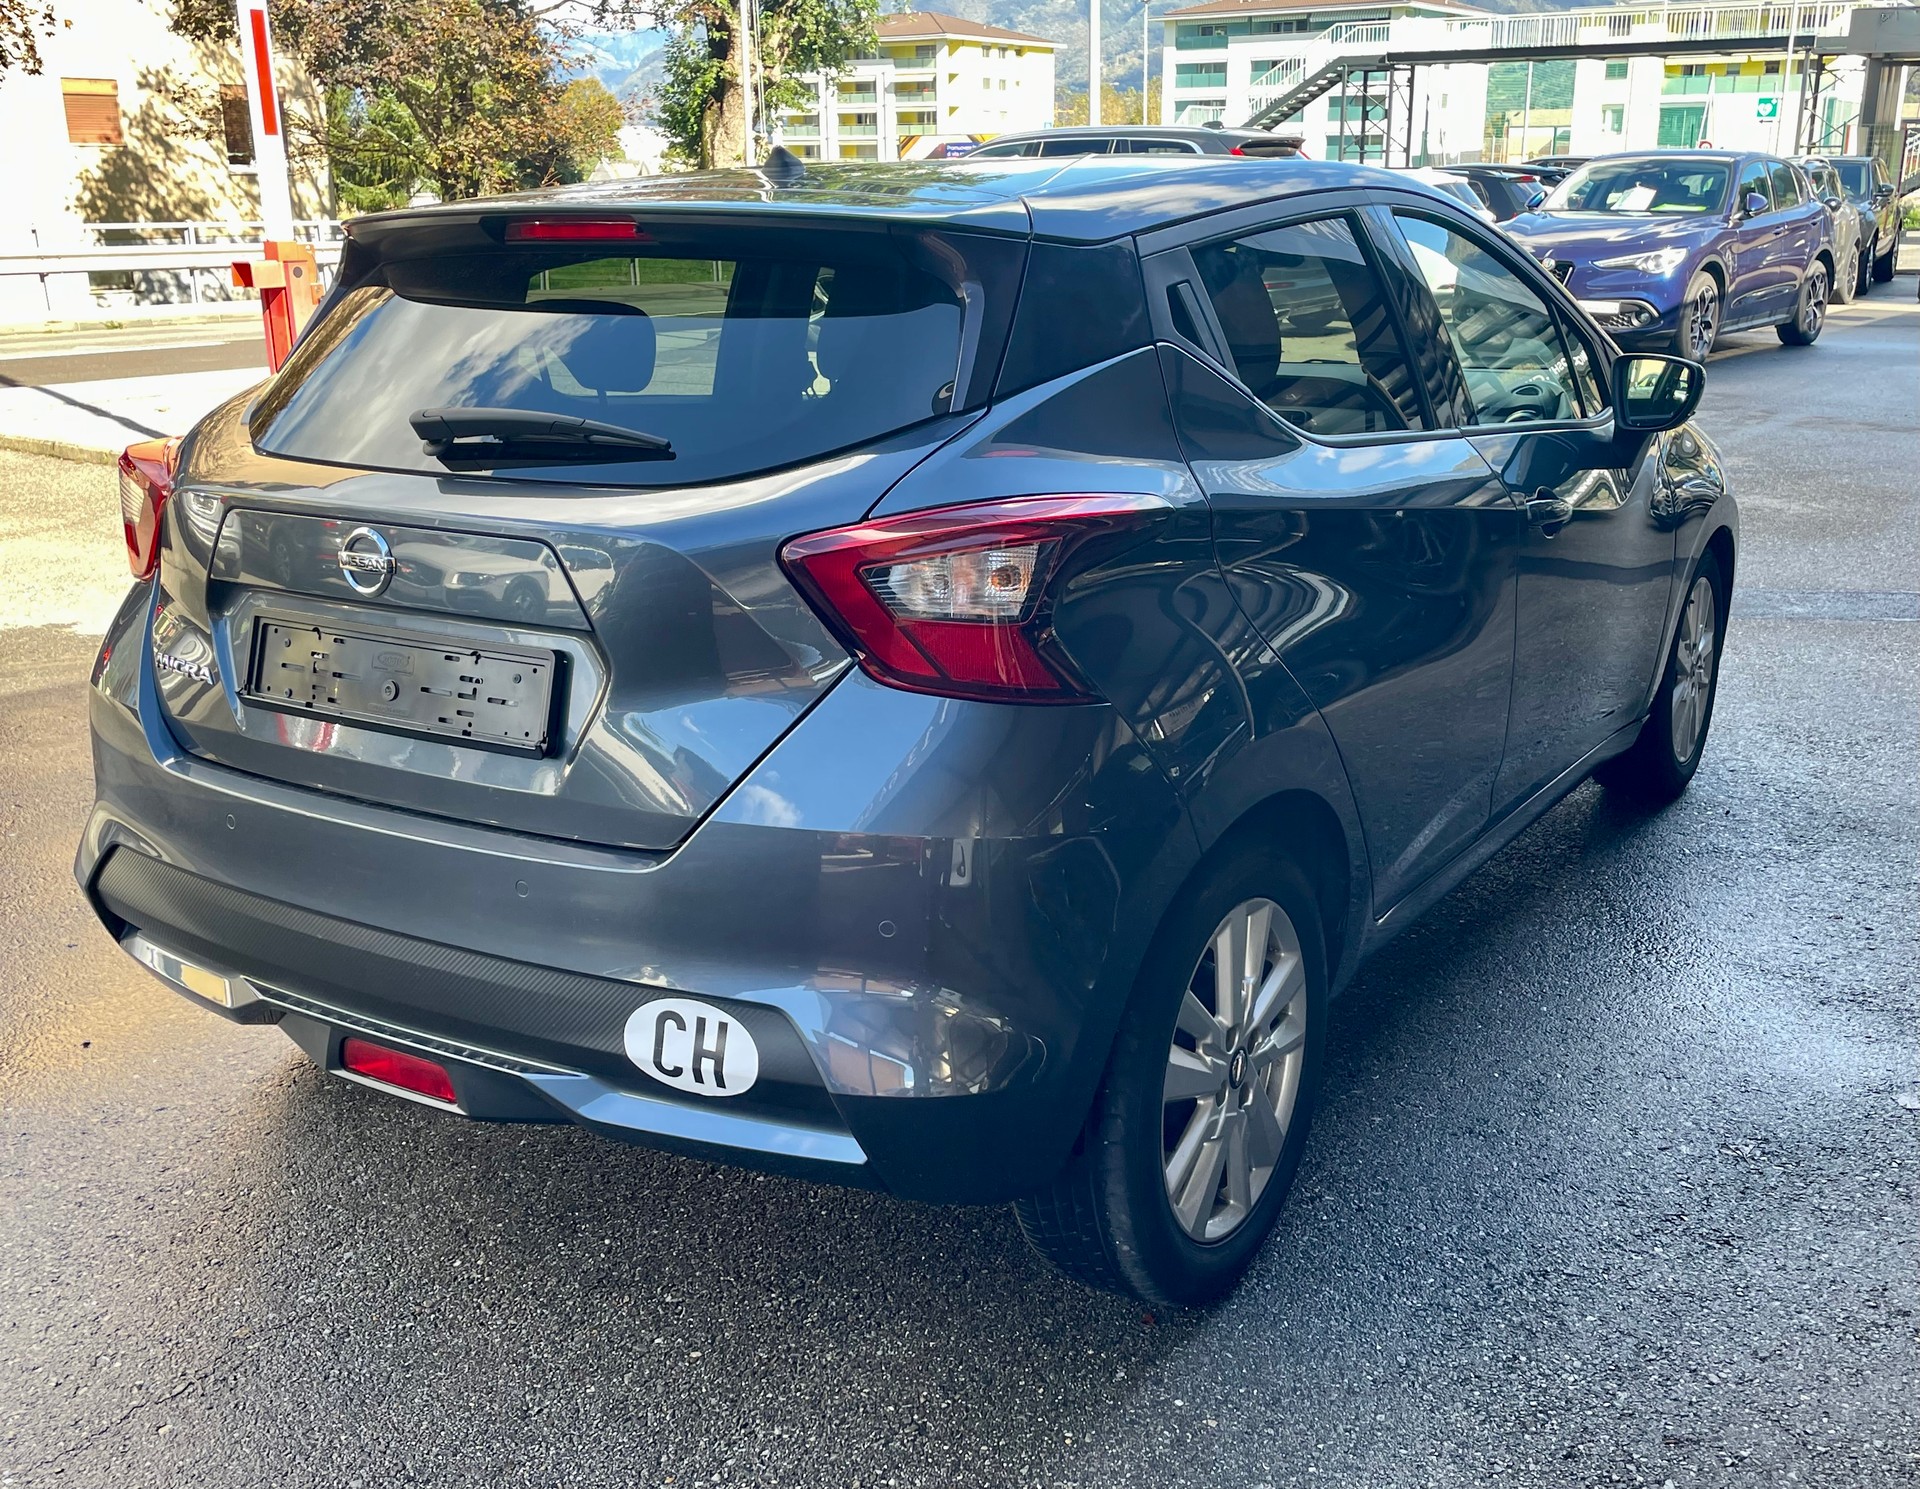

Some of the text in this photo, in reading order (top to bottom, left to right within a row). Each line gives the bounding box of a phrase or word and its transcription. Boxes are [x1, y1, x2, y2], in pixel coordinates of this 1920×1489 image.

[341, 555, 387, 573] NISSAN
[156, 652, 214, 686] MICRA
[653, 1010, 728, 1089] CH
